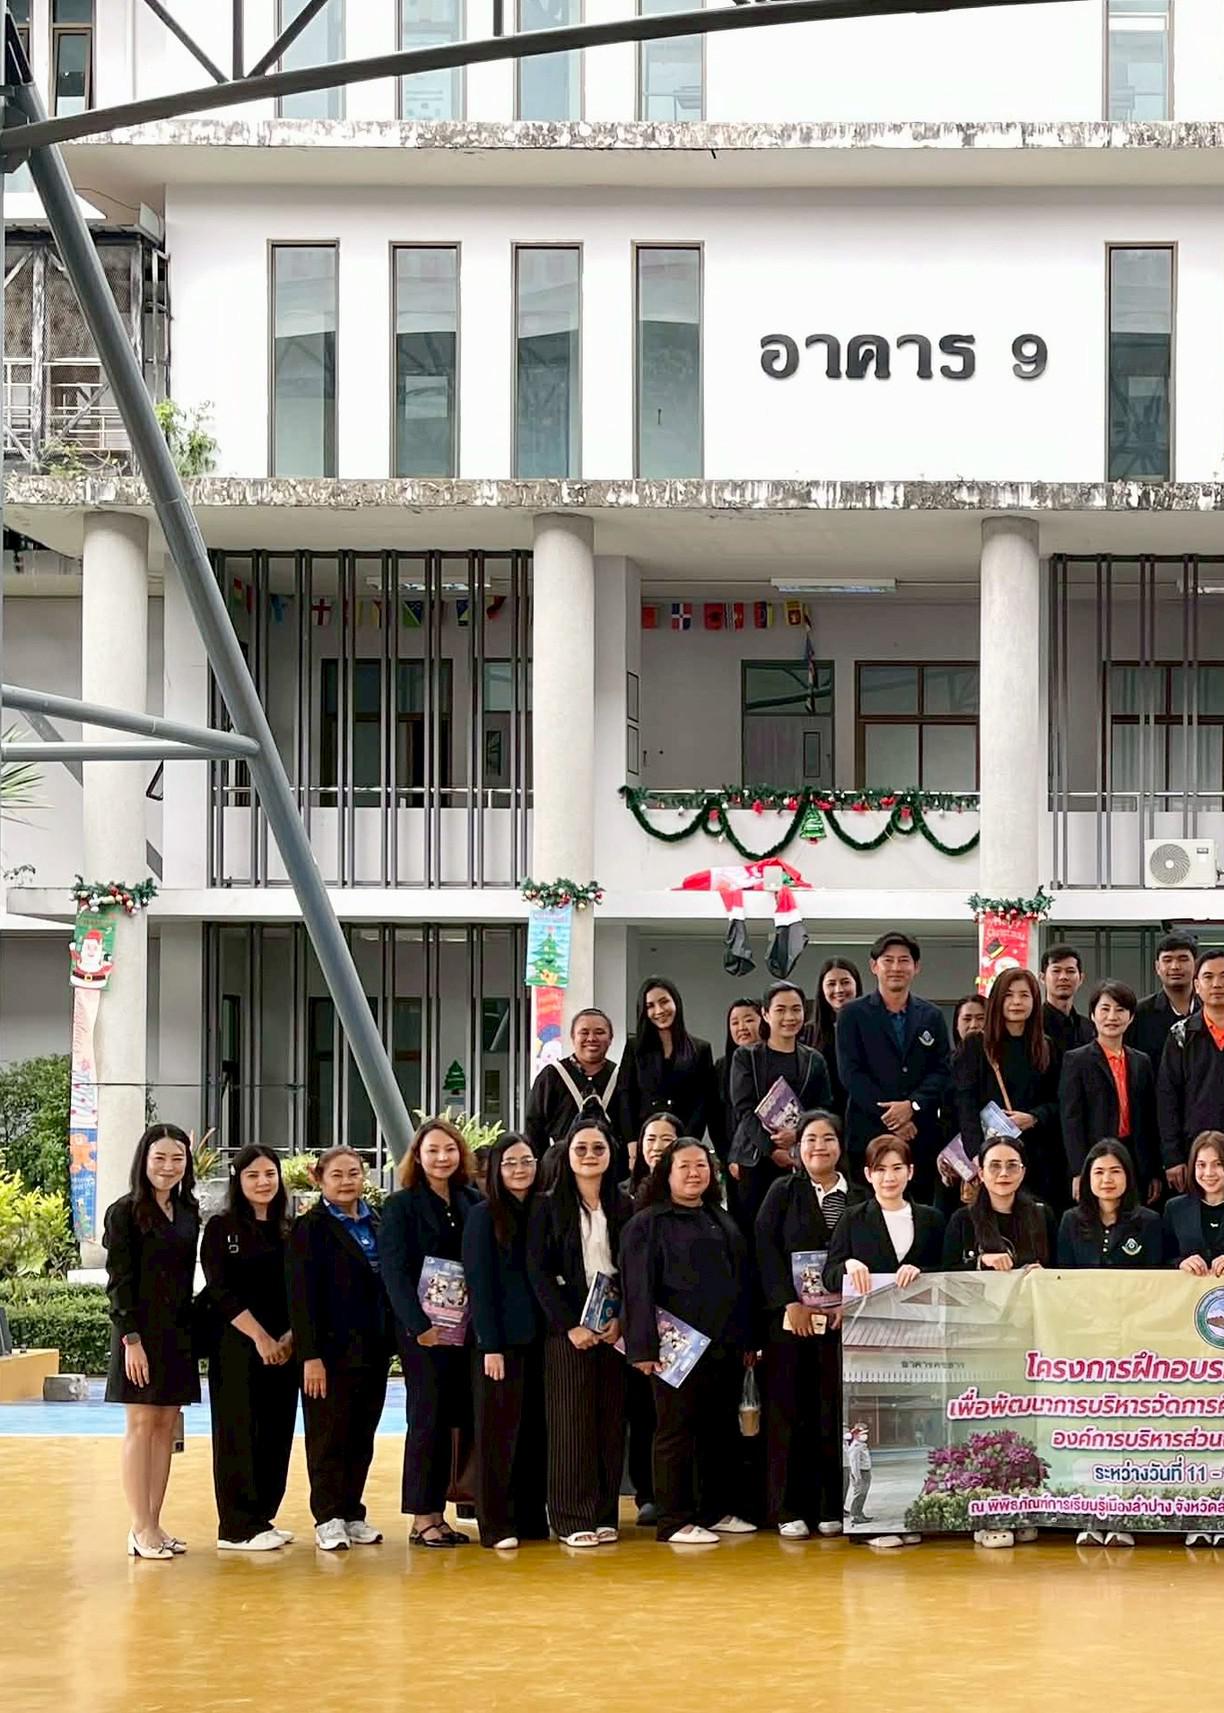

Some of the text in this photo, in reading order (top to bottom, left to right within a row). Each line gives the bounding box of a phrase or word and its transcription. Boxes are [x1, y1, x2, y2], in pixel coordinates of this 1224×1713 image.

[760, 333, 1048, 379] อาคาร 9
[1094, 1456, 1183, 1482] ระหว่างวันที่
[1187, 1464, 1206, 1482] 11
[970, 1501, 985, 1514] ณ
